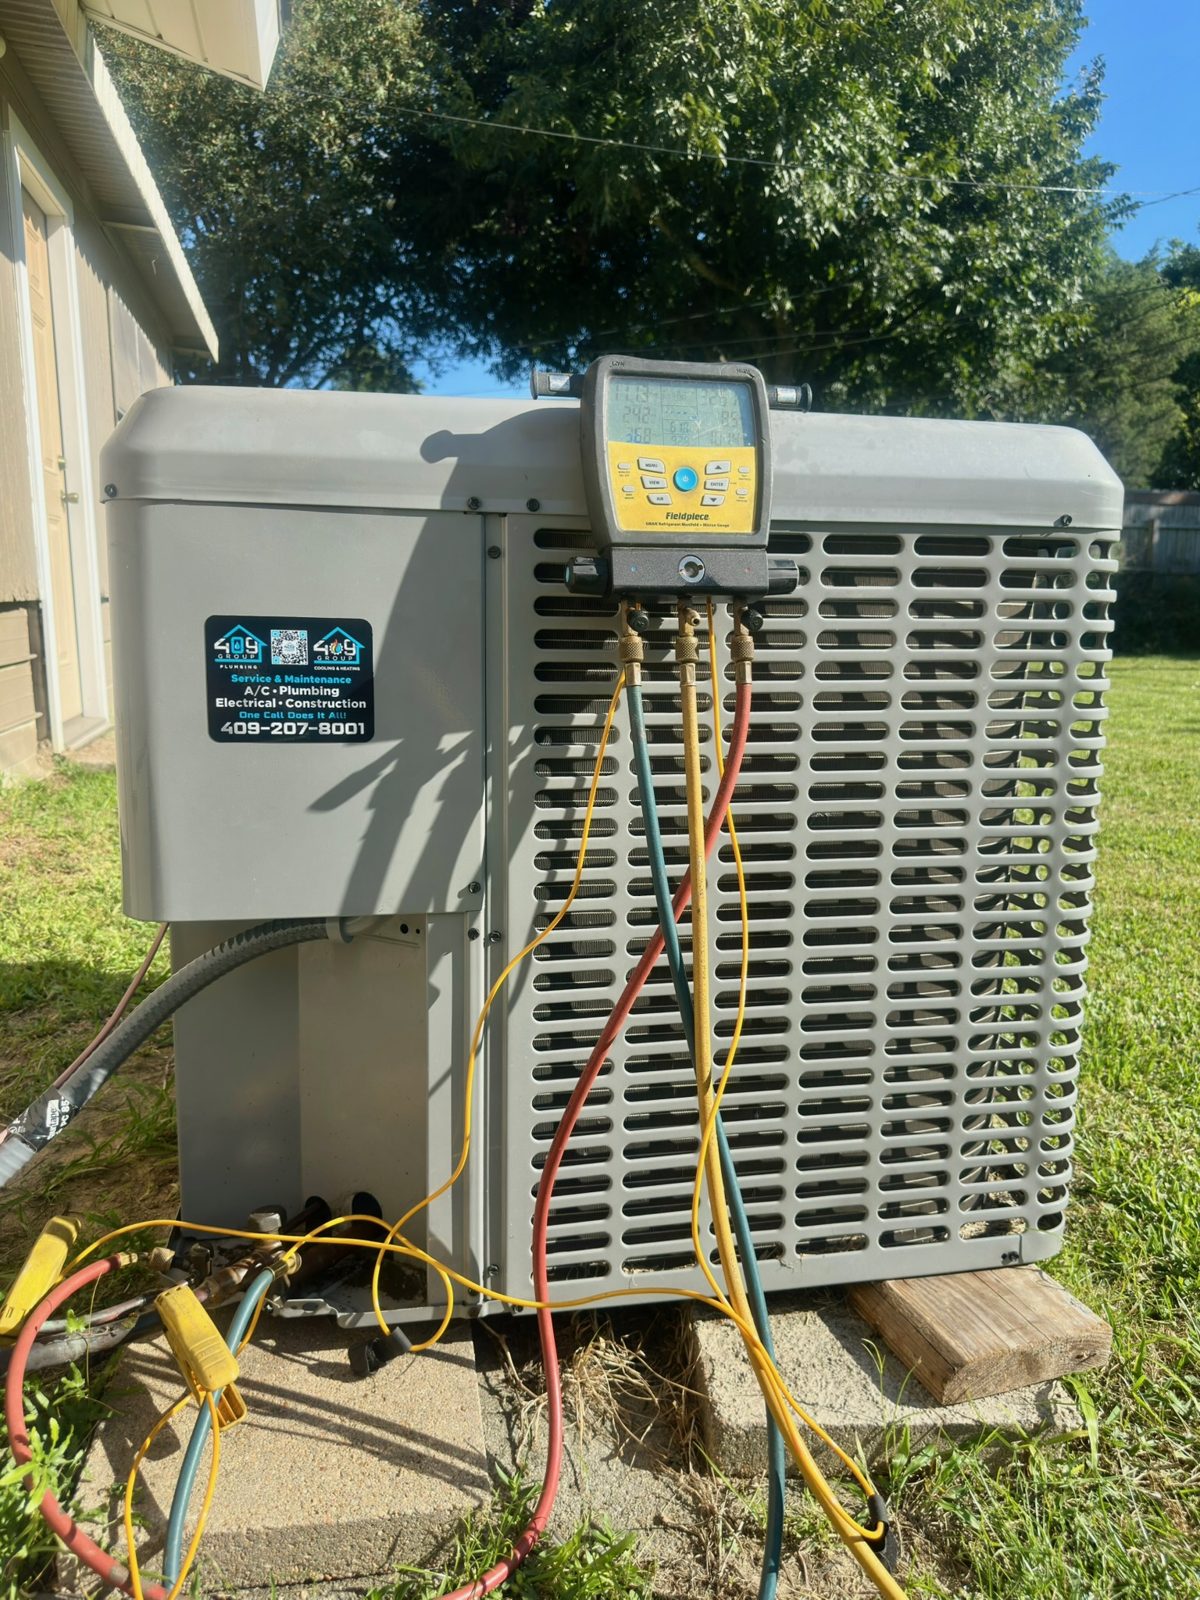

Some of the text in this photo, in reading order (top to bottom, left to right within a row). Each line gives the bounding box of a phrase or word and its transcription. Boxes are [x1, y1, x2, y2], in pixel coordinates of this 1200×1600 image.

[665, 512, 709, 521] Fieldpiece
[214, 636, 258, 654] 409
[231, 674, 352, 684] Service & Maintenance
[244, 685, 340, 698] A/C Plumbing
[215, 698, 367, 709] Electrical Construction
[239, 711, 260, 719] One
[263, 711, 285, 719] Call
[220, 721, 365, 735] 409-207-8001
